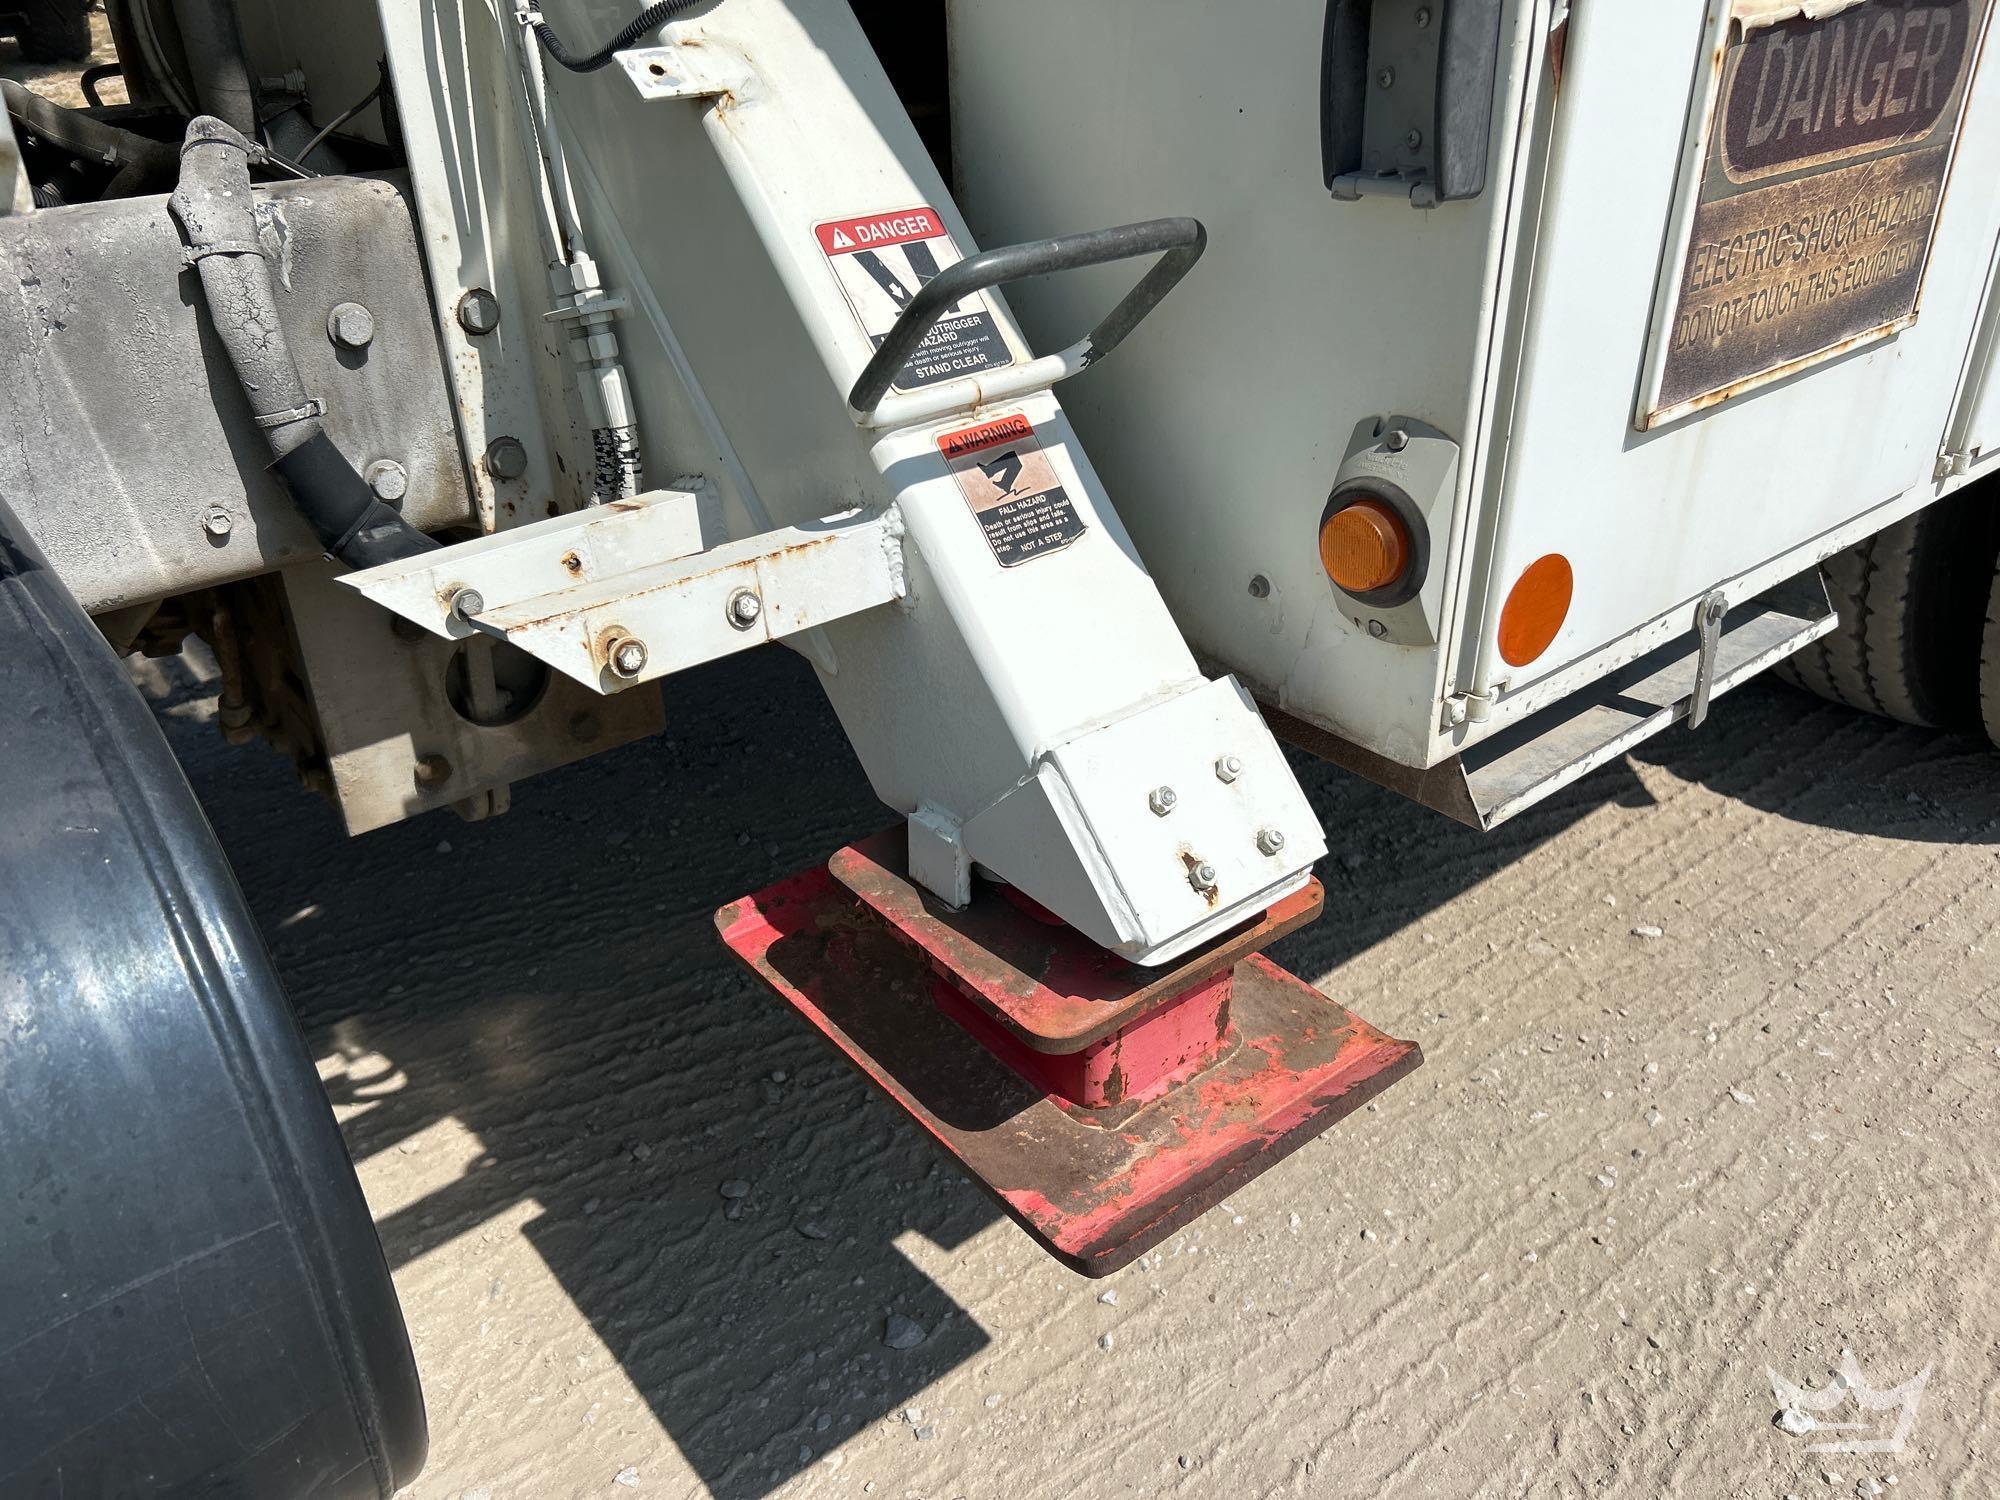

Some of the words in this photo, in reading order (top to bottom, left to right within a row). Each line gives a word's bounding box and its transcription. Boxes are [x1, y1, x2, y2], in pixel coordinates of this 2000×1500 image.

[1746, 8, 1952, 148] DANGER
[855, 214, 932, 243] DANGER
[1689, 221, 1793, 292] ELECTRIC
[1792, 206, 1861, 261] SHOCK
[1863, 182, 1935, 237] HAZARD
[1676, 313, 1702, 350] DO
[1703, 299, 1740, 339] NOT
[1746, 276, 1801, 325] TOUCH
[1807, 264, 1840, 307] THIS
[1843, 237, 1924, 296] EQUIPMENT
[915, 355, 932, 366] death
[941, 351, 962, 360] serious
[916, 349, 929, 358] with
[930, 344, 952, 355] moving
[953, 338, 979, 349] outrigger
[916, 360, 951, 379] STAND
[952, 353, 988, 368] CLEAR
[961, 419, 1027, 449] WARNING
[984, 520, 1003, 532] Death
[1013, 511, 1035, 523] serious
[1035, 505, 1052, 515] injury
[1054, 498, 1070, 509] could
[998, 505, 1016, 516] FALL
[1017, 494, 1046, 509] HAZARD
[988, 528, 1007, 539] result
[1007, 524, 1023, 533] from
[1023, 518, 1038, 528] slips
[1039, 513, 1050, 522] and
[1051, 509, 1066, 518] falls.
[991, 538, 1001, 547] Do
[1003, 533, 1014, 543] not
[1015, 531, 1027, 539] use
[1027, 525, 1039, 535] this
[1040, 521, 1054, 529] area
[996, 545, 1012, 554] step.
[1020, 541, 1038, 552] NOT
[1038, 538, 1045, 547] A
[1046, 532, 1063, 544] STEP
